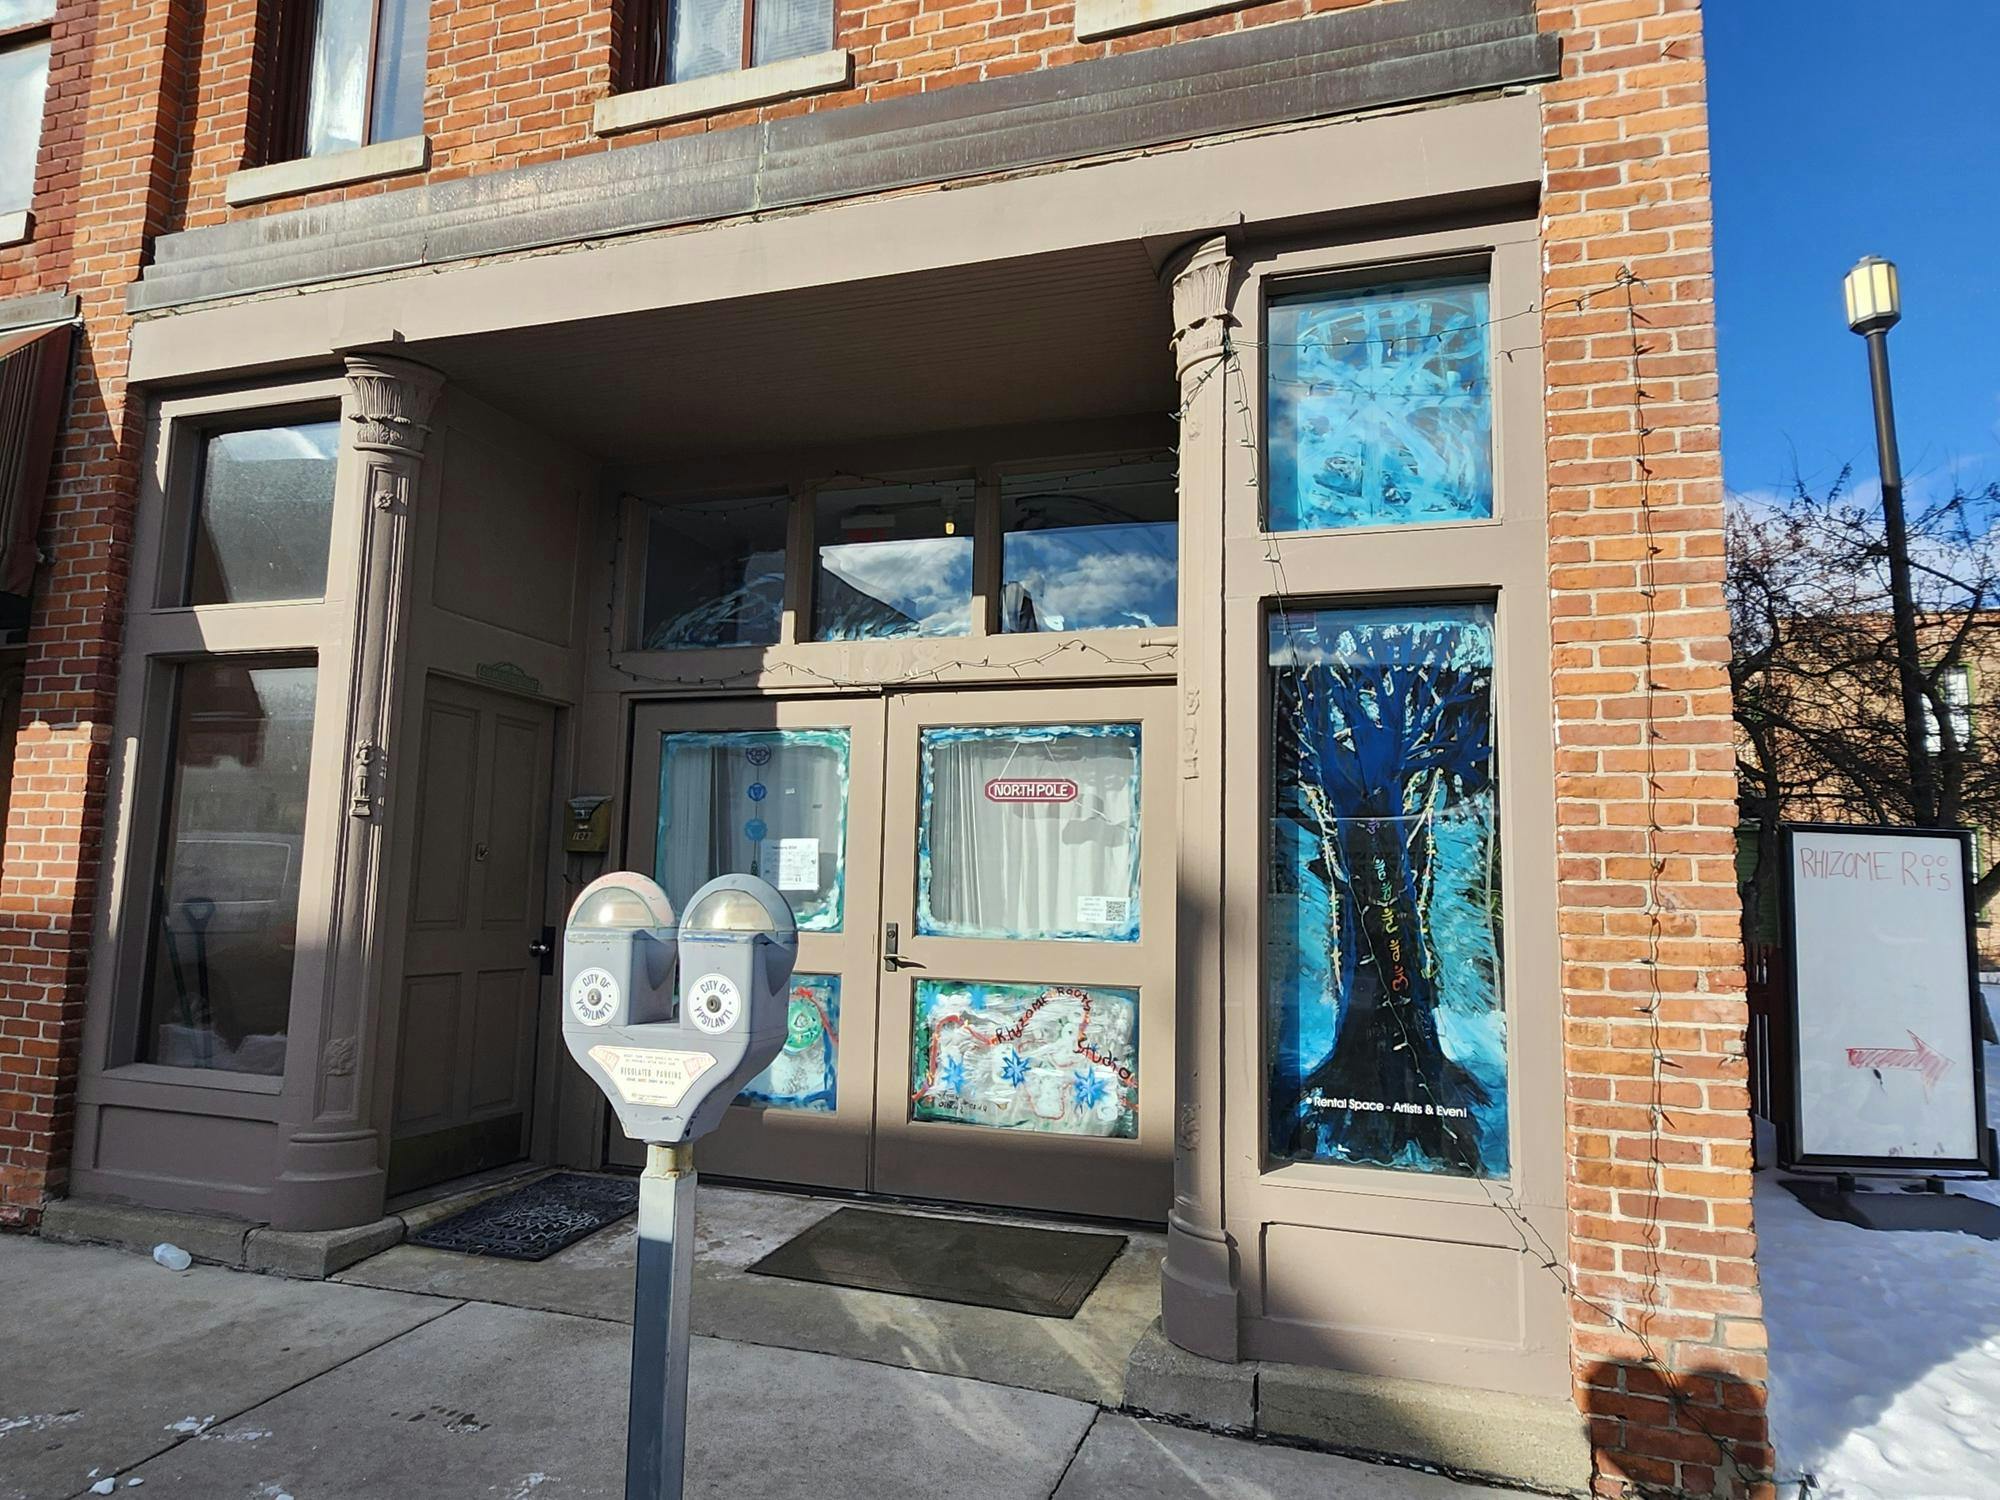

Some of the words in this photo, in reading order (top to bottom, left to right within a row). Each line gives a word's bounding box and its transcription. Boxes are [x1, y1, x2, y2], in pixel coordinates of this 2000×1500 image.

[994, 784, 1035, 797] NORTH
[1036, 784, 1069, 797] POLE
[1800, 847, 1893, 881] RHIZOME
[582, 973, 600, 987] CITY
[600, 976, 611, 989] OF
[700, 980, 719, 994] CITY
[719, 983, 731, 995] OF
[576, 998, 613, 1021] YPSILANTI
[694, 1006, 733, 1028] YPSILANTI
[1314, 1097, 1347, 1109] Rental
[1348, 1098, 1385, 1112] Space
[1393, 1102, 1423, 1115] Artists
[1425, 1104, 1434, 1115] &
